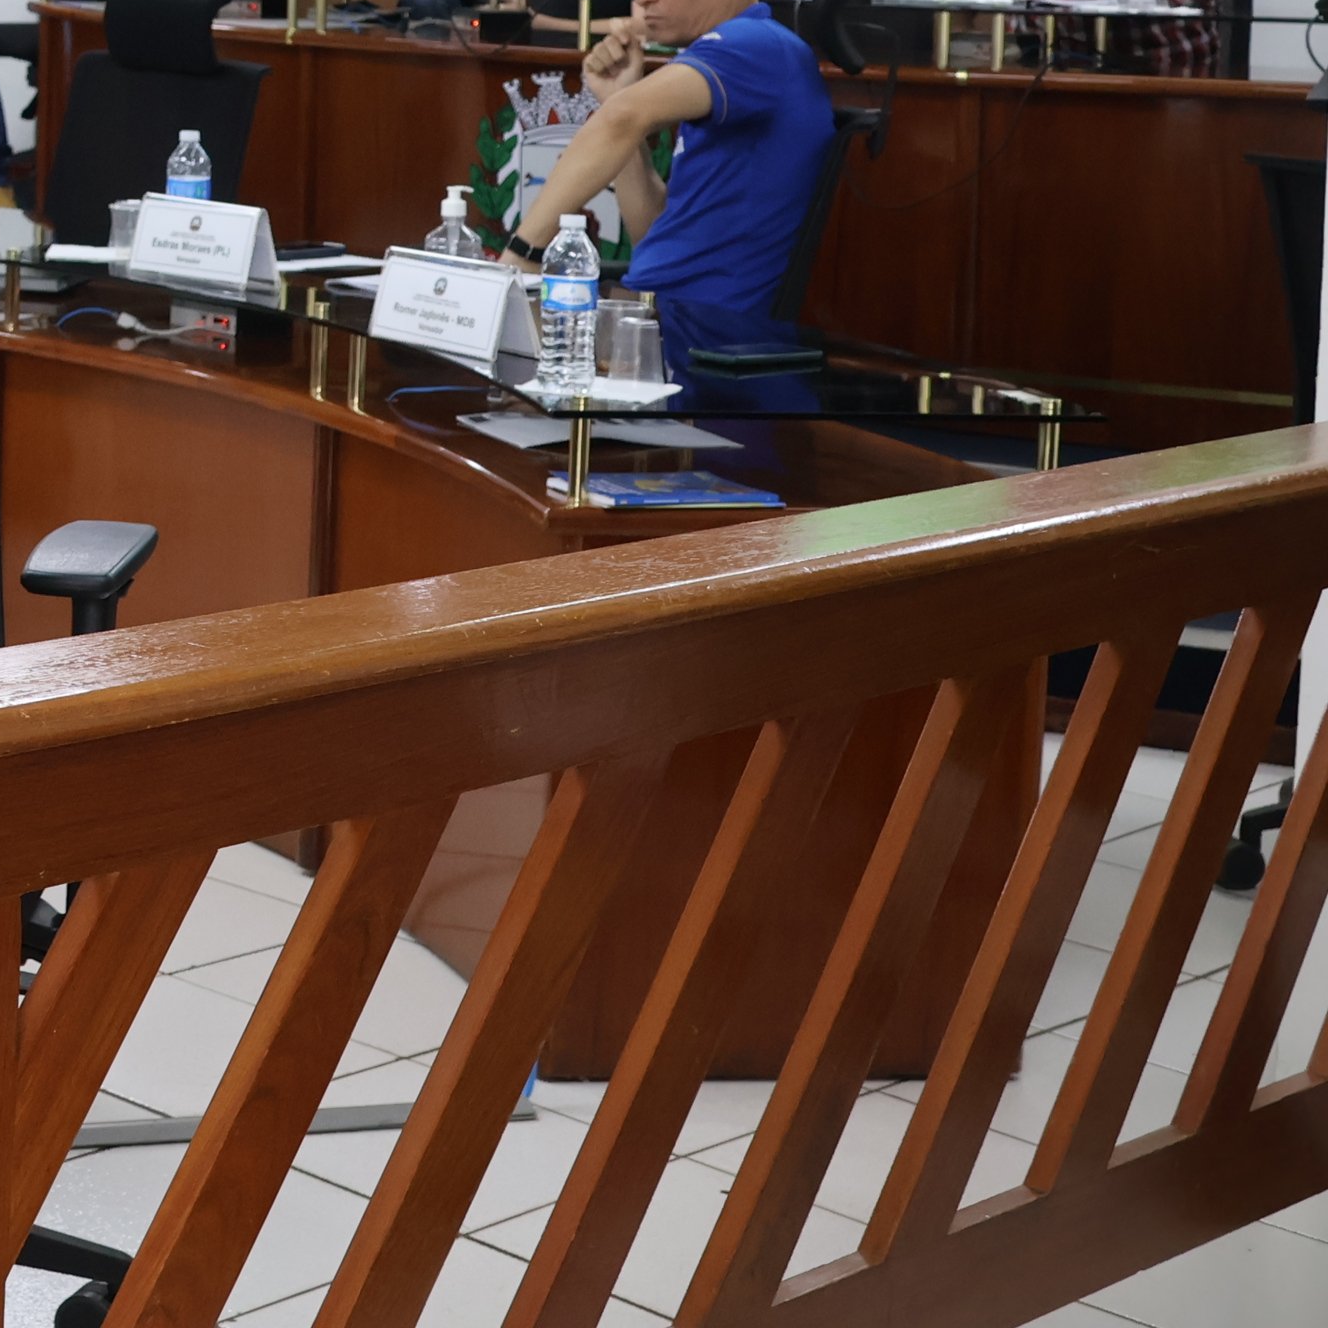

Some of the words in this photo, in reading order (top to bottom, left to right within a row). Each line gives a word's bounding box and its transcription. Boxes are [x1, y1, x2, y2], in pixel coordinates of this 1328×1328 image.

[151, 237, 179, 250] Esdras
[182, 241, 211, 254] Moraes
[456, 315, 476, 329] MDB
